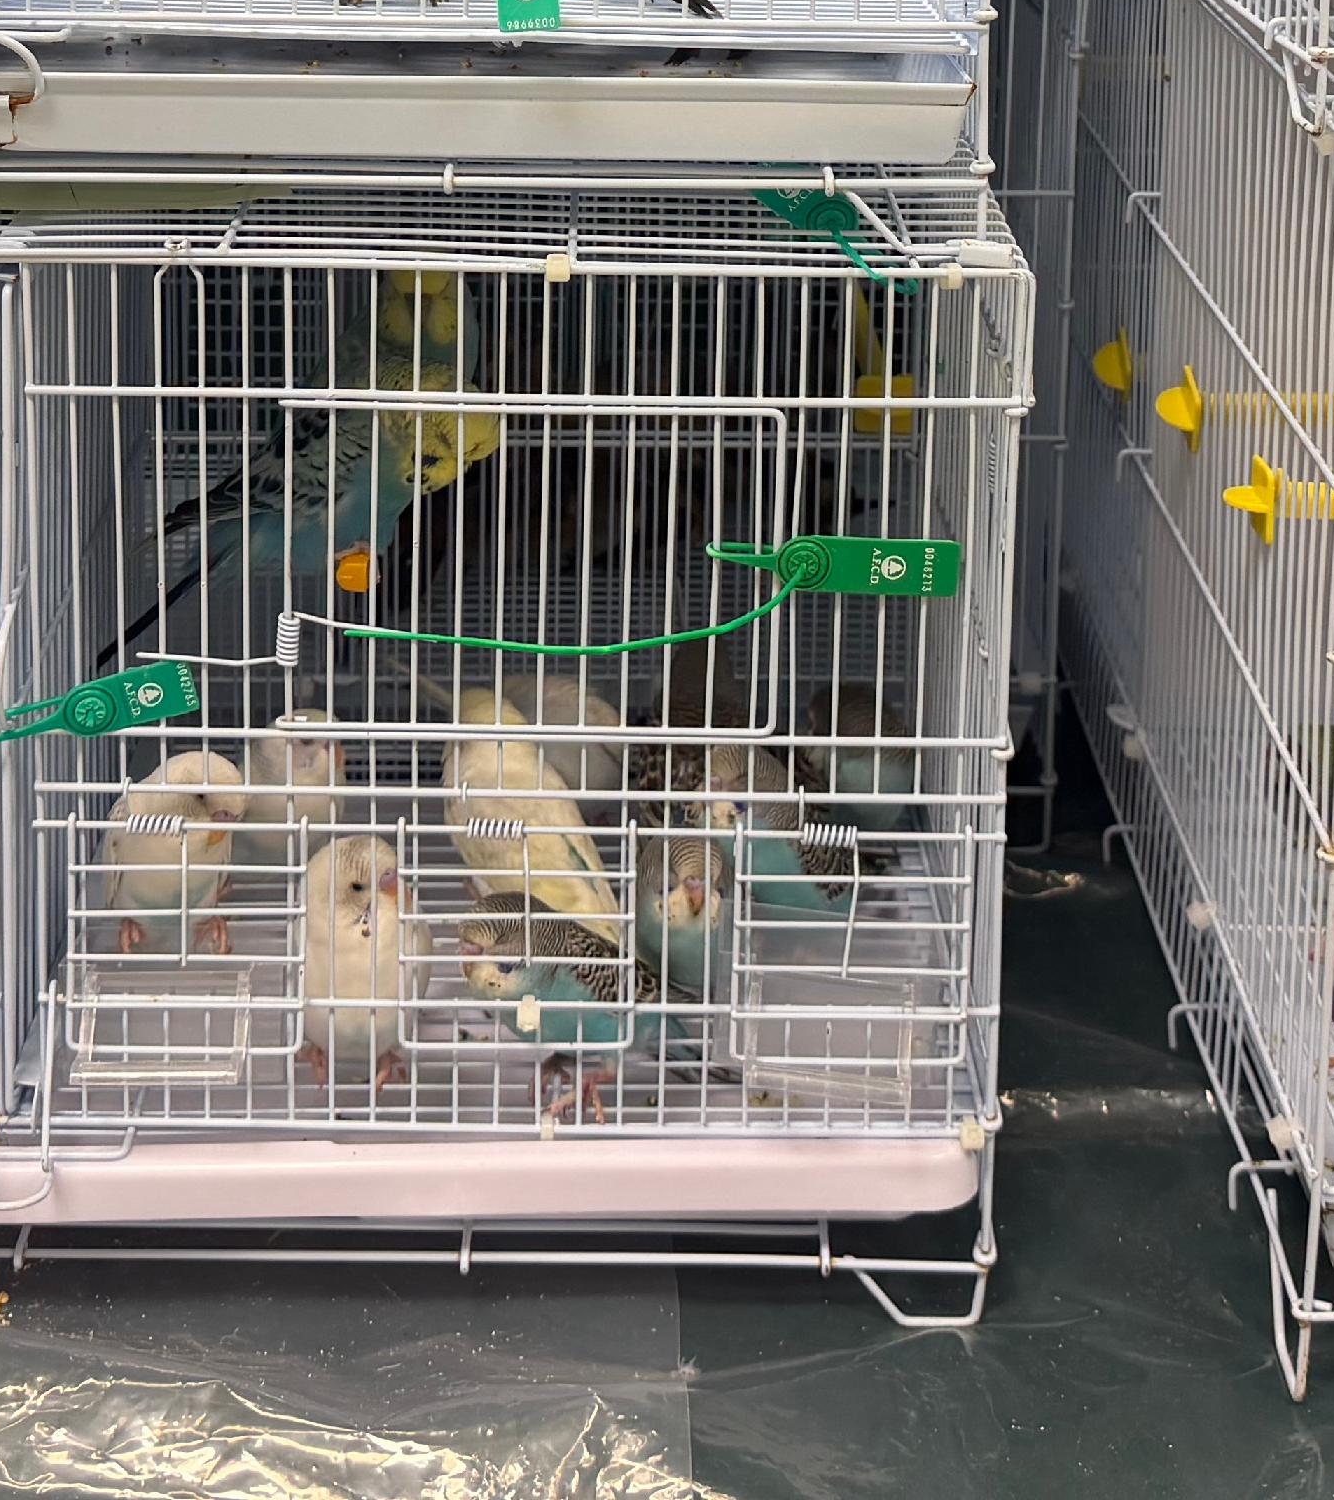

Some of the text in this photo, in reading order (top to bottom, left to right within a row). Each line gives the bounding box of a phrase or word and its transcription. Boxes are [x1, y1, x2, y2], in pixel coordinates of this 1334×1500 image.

[506, 17, 555, 30] 0039986
[870, 548, 882, 586] A.F.C.D.
[123, 682, 141, 717] A.F.C.D.
